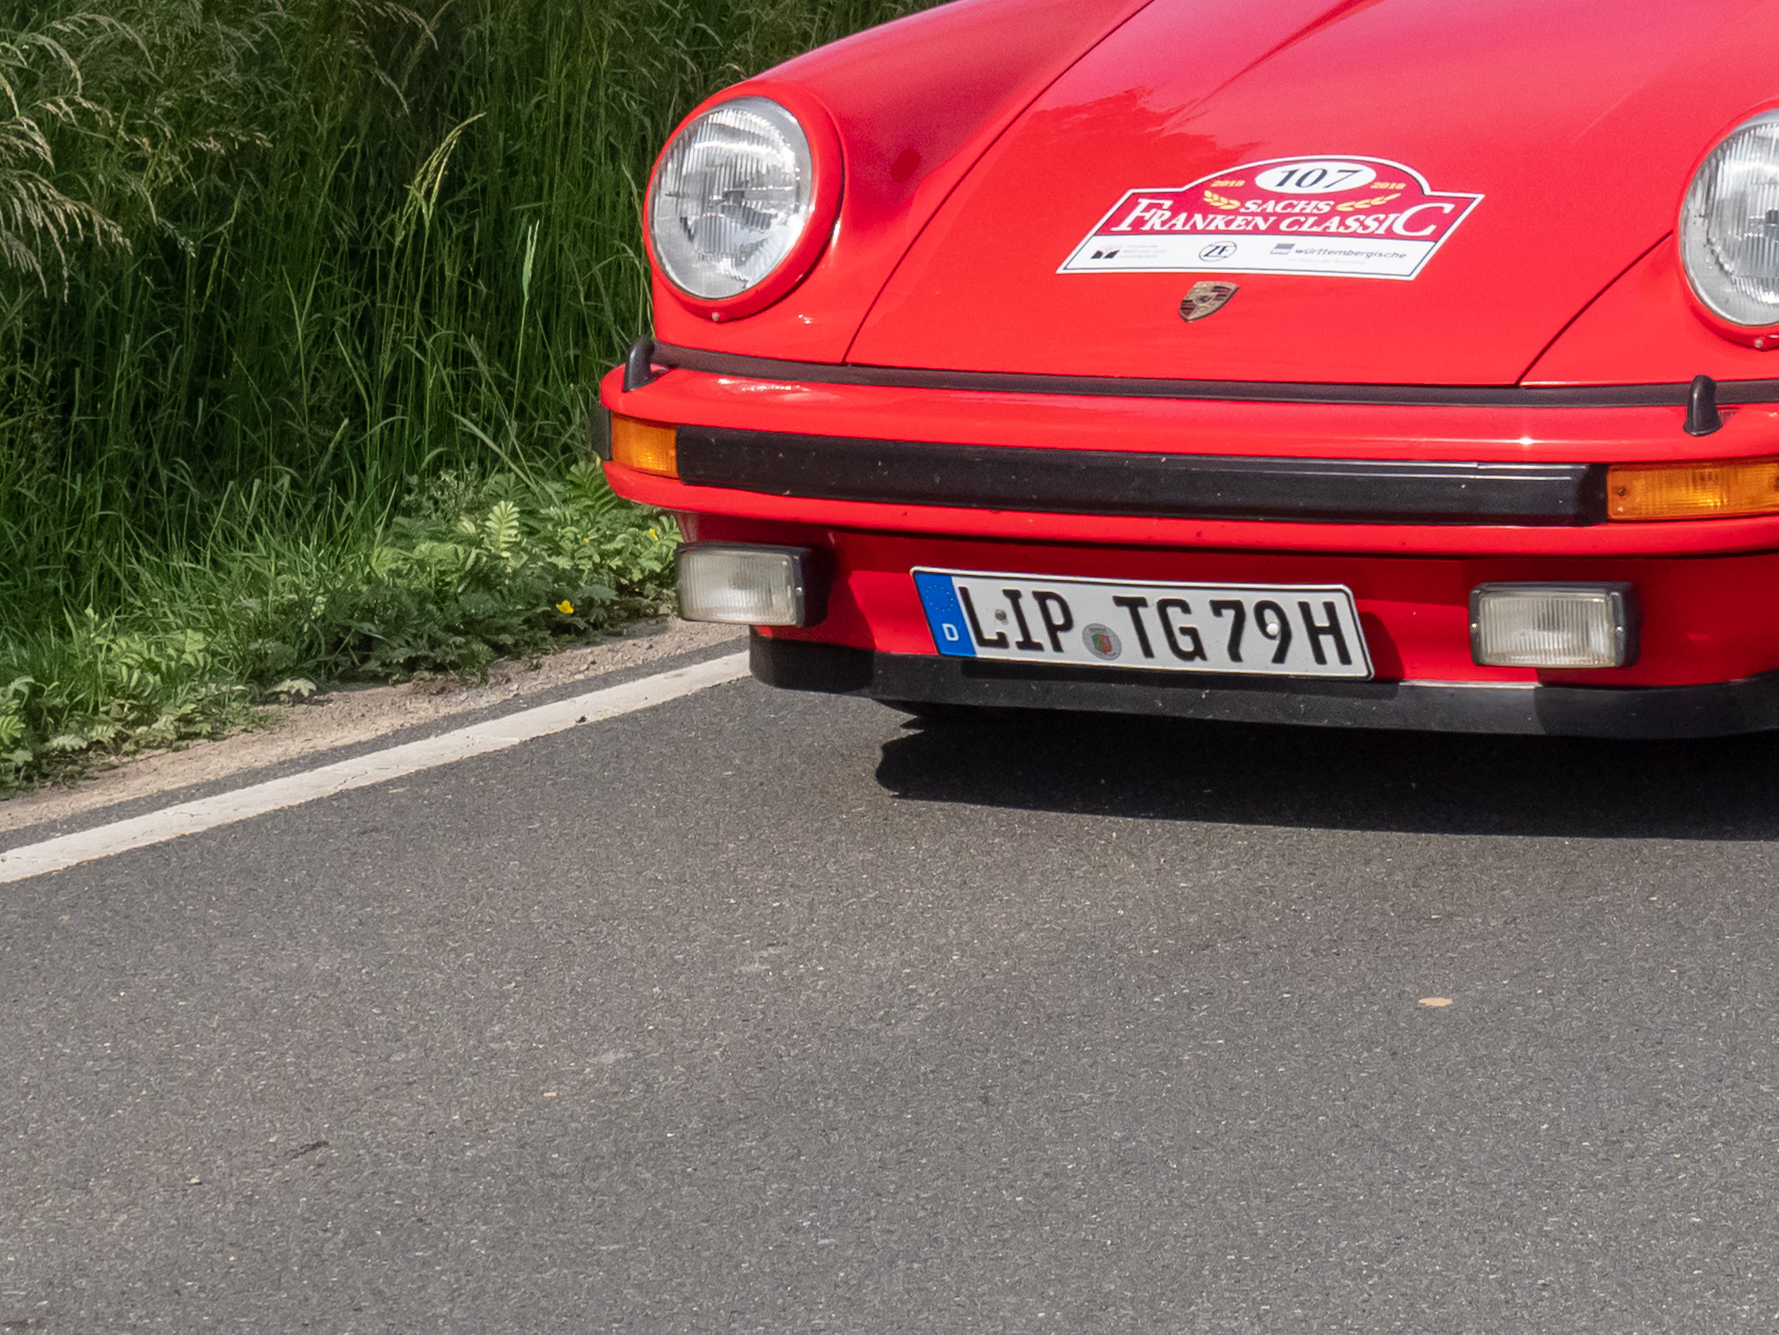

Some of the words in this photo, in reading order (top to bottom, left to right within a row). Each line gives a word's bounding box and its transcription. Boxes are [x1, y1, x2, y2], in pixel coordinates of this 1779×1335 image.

[1275, 168, 1364, 189] 107
[1239, 199, 1335, 214] SACHS
[1111, 198, 1278, 231] FRANKEN
[1279, 203, 1455, 236] CLASSIC
[1295, 245, 1407, 259] württembergische
[958, 586, 1075, 653] LIP
[942, 623, 960, 642] D
